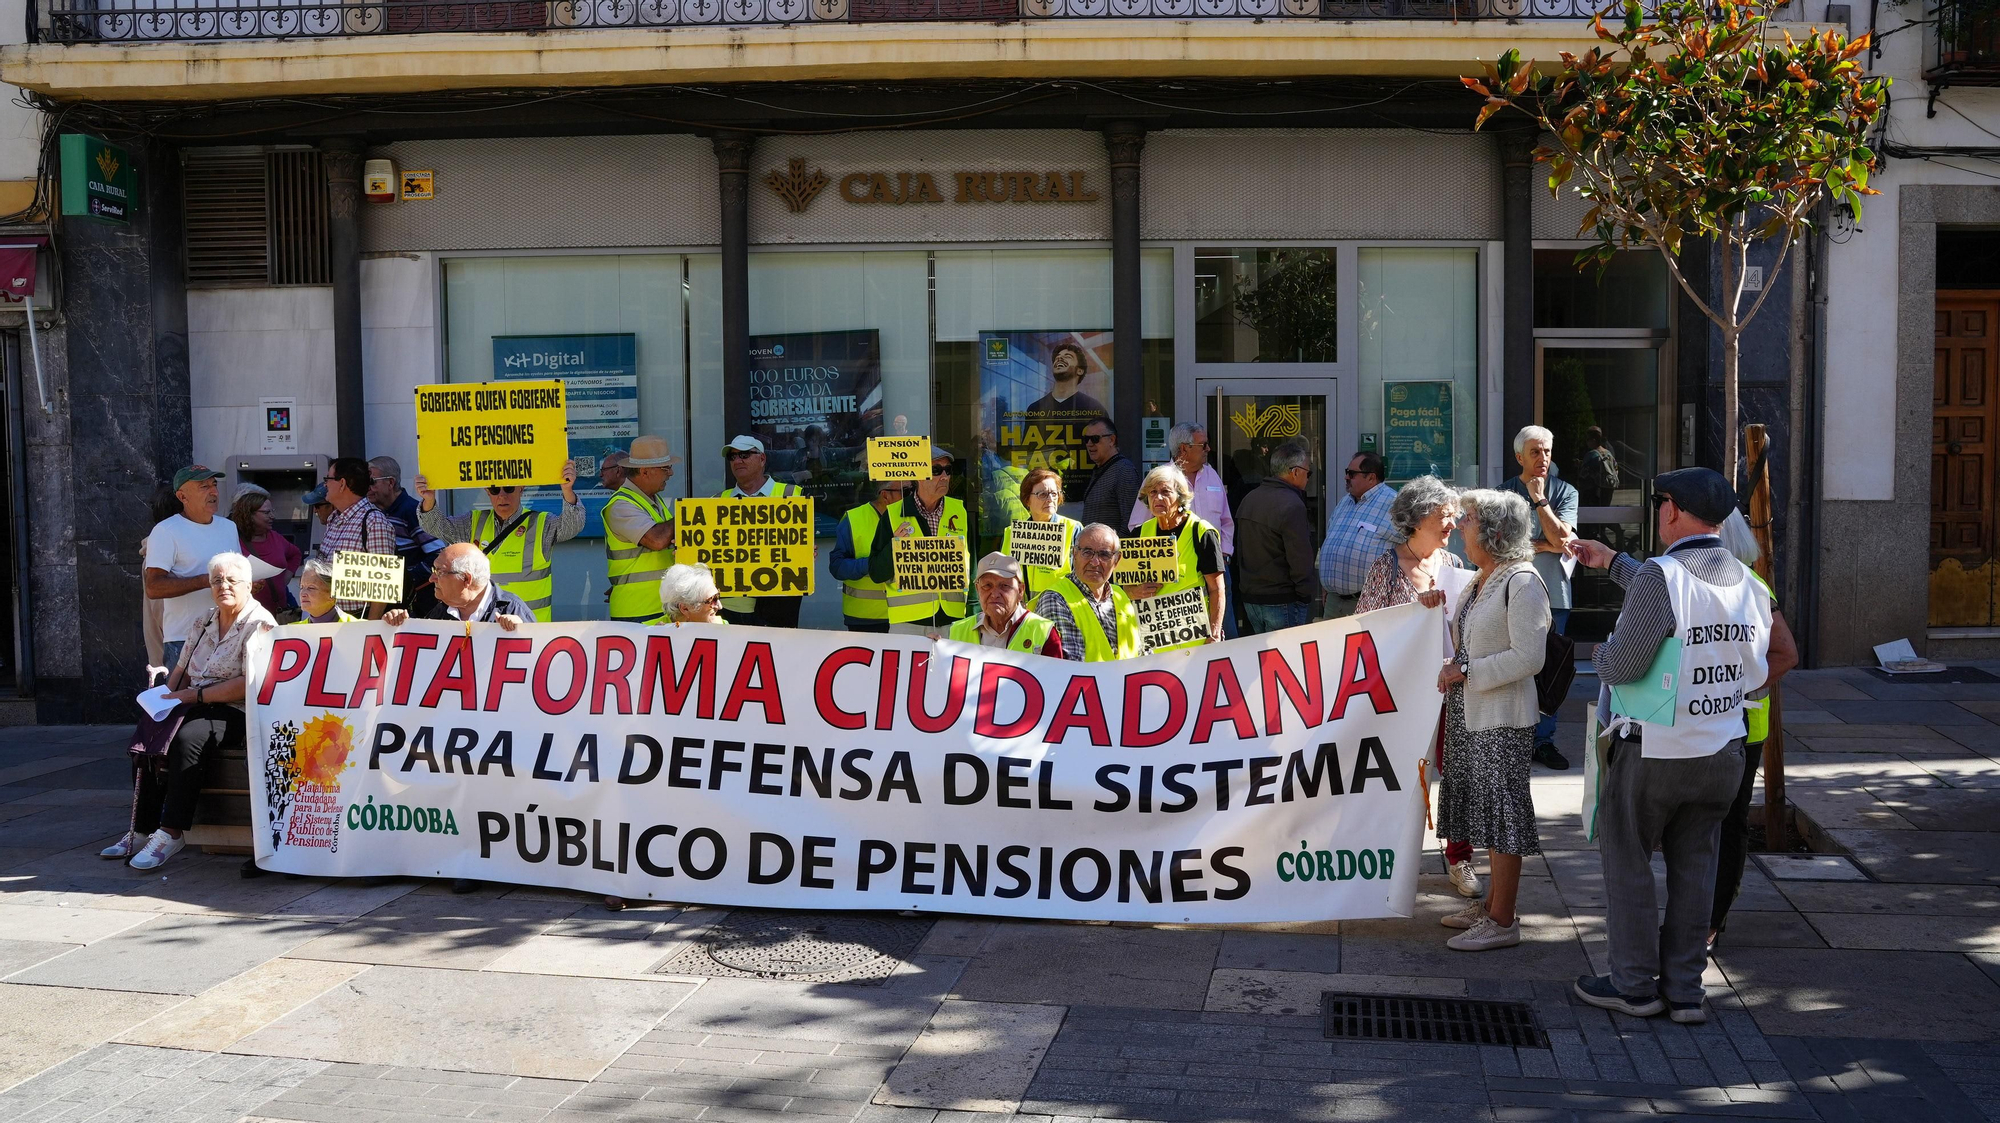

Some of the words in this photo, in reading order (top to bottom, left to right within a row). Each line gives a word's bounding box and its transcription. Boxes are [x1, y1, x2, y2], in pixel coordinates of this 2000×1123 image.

[89, 181, 105, 193] CAJA
[106, 185, 127, 198] RURAL
[839, 172, 944, 205] CAJA
[954, 171, 1098, 202] RURAL
[101, 203, 123, 216] ServiRed
[1744, 270, 1760, 287] 14
[533, 351, 585, 370] Digital
[750, 369, 779, 384] 100
[784, 366, 840, 382] EUROS
[750, 385, 783, 399] POR
[788, 382, 832, 397] CADA
[420, 391, 472, 413] GOBIERNE
[475, 390, 507, 412] QUIEN
[509, 388, 561, 410] GOBIERNE
[751, 395, 857, 418] SOBRESALIENTE
[1051, 409, 1102, 417] PROFESIONAL
[1390, 407, 1416, 418] Paga
[1418, 407, 1442, 416] fácil.
[752, 417, 790, 425] HASTA
[1390, 418, 1417, 427] Gana
[1420, 418, 1444, 427] fácil.
[450, 425, 472, 447] LAS
[475, 424, 534, 446] PENSIONES
[877, 438, 920, 448] PENSIÓN
[1001, 425, 1088, 446] HAZL
[1413, 440, 1432, 453] 8%
[891, 451, 908, 460] NO
[1011, 443, 1096, 470] FÁCIL
[459, 460, 472, 481] SE
[476, 459, 532, 481] DEFIENDEN
[885, 470, 916, 478] DIGNA
[681, 506, 706, 526] LA
[716, 500, 808, 526] PENSIÓN
[1012, 519, 1064, 532] ESTUDIANTE
[681, 529, 705, 547] NO
[712, 529, 730, 546] SE
[737, 528, 808, 546] DEFIENDE
[901, 540, 911, 550] DE
[914, 539, 956, 550] NUESTRAS
[1012, 531, 1062, 542] TRABAJADOR
[1120, 538, 1174, 549] ENSIONES
[1011, 542, 1046, 551] LUCHAMOS
[1048, 545, 1061, 553] POR
[1121, 548, 1174, 560] ÚBLICAS
[336, 553, 401, 569] PENSIONES
[697, 548, 761, 564] DESDE
[770, 548, 792, 563] EL
[895, 551, 963, 563] PENSIONES
[1011, 551, 1021, 562] TU
[1023, 551, 1062, 567] PENSIÓN
[344, 569, 361, 578] EN
[368, 571, 391, 580] LOS
[896, 564, 924, 574] VIVEN
[927, 564, 964, 573] MUCHOS
[1115, 570, 1158, 584] PRIVADAS
[1162, 569, 1175, 582] NO
[709, 564, 808, 592] LLÓN
[899, 574, 965, 590] MILLONES
[335, 580, 399, 601] PRESUPUESTOS
[1135, 600, 1151, 613] LA
[1154, 590, 1202, 609] PENSIÓN
[1139, 614, 1152, 625] NO
[1155, 611, 1165, 621] SE
[1167, 603, 1203, 618] DEFIENDE
[1149, 619, 1181, 632] DESDE
[1187, 616, 1197, 626] EL
[1144, 624, 1208, 650] SILLÓN
[257, 633, 786, 725] PLATAFORMA
[813, 630, 1398, 748] CIUDADANA
[369, 723, 516, 778] PARA
[532, 733, 599, 783] LA
[617, 734, 922, 804] DEFENSA
[943, 753, 1073, 811] DEL
[1093, 736, 1402, 814] SISTEMA
[296, 781, 341, 794] Plataforma
[294, 791, 336, 804] Ciudadana
[294, 804, 312, 813] para
[314, 803, 321, 813] la
[347, 795, 460, 836] CÓRDOBA
[290, 812, 304, 823] del
[288, 822, 325, 836] Público
[326, 827, 333, 836] de
[330, 813, 341, 854] Córdoba
[285, 833, 332, 848] Pensiones
[478, 803, 728, 881] PÚBLICO
[748, 832, 836, 889] DE
[856, 840, 1251, 904] PENSIONES
